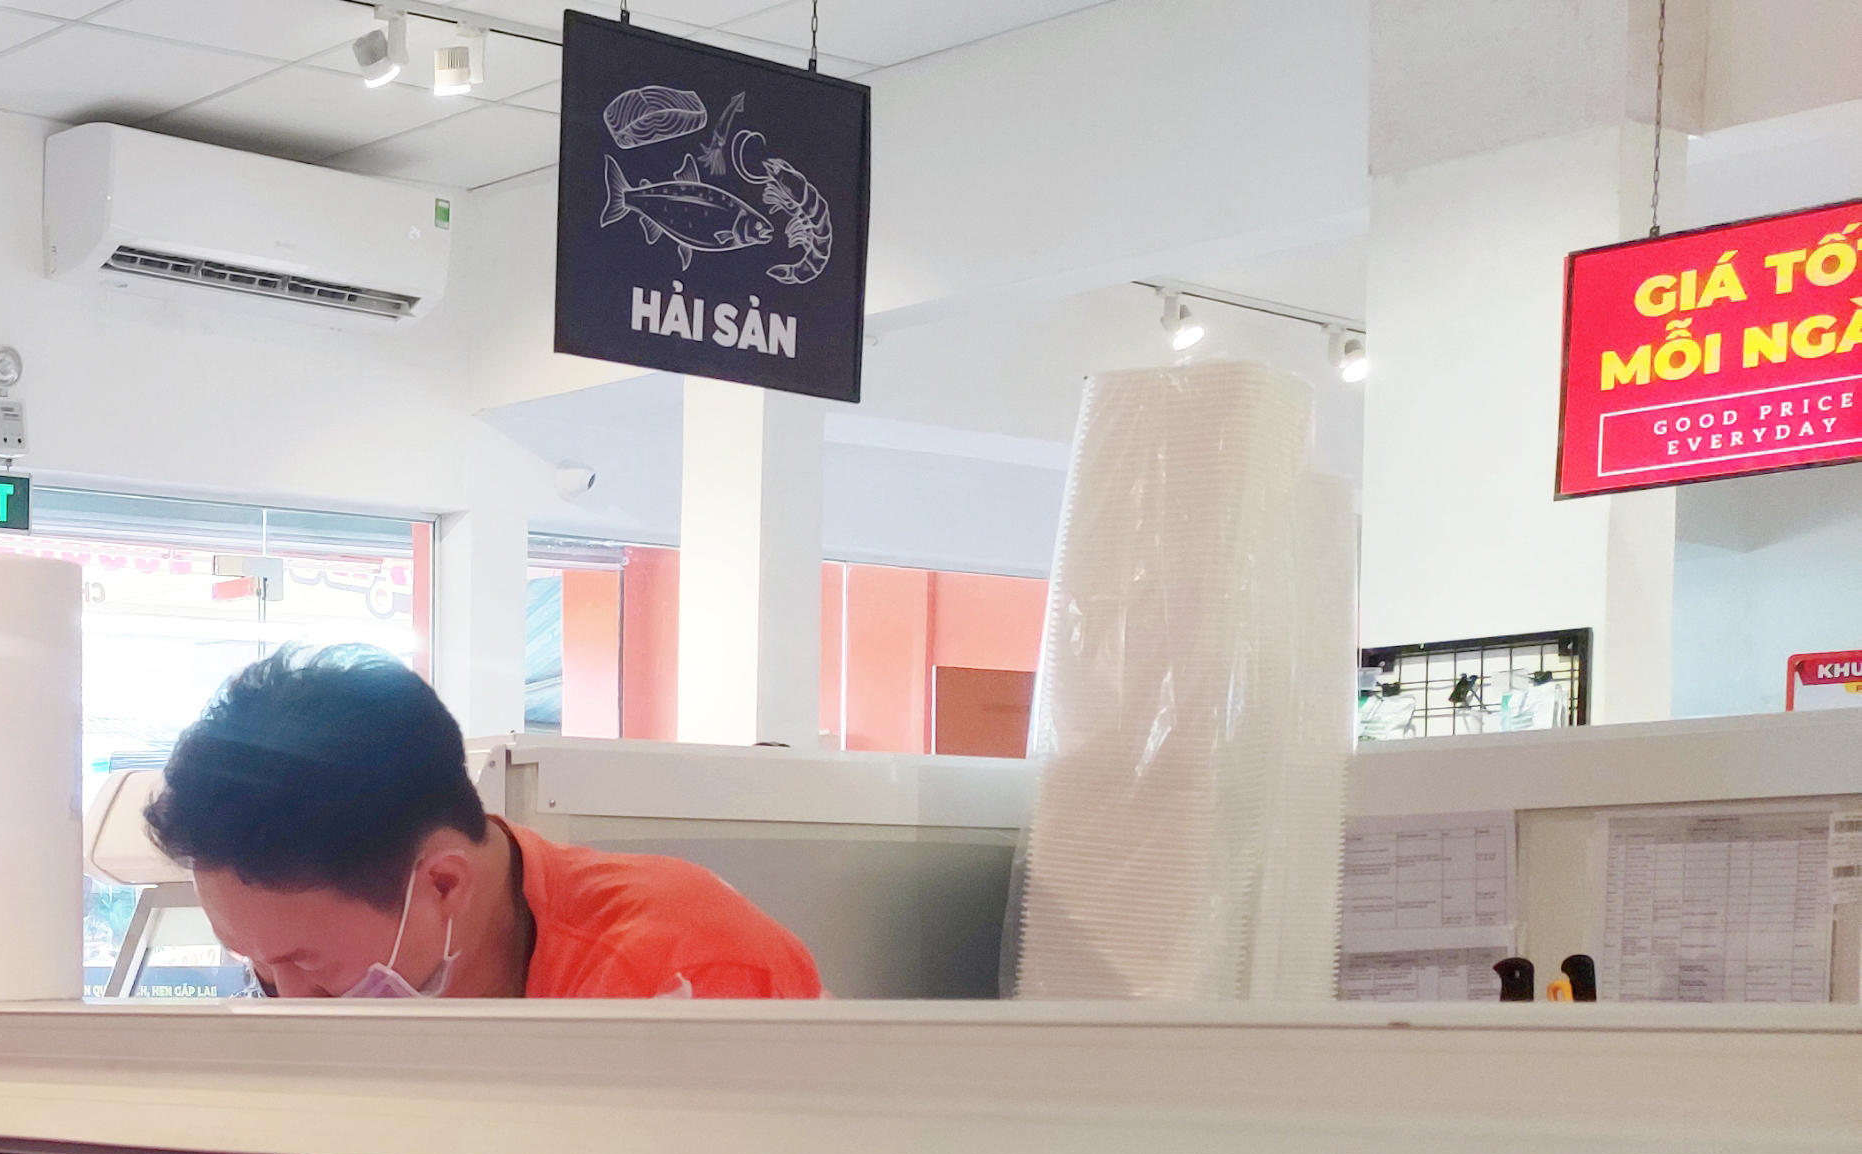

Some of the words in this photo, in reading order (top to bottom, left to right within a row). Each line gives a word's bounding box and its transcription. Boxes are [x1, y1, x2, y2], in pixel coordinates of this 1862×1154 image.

[1634, 249, 1748, 317] GIÁ
[1764, 222, 1862, 295] TỐ
[631, 280, 705, 342] HẢI
[711, 294, 797, 359] SẢN
[1600, 317, 1722, 391] MỖI
[1653, 409, 1738, 435] GOOD
[1758, 392, 1854, 421] PRICE
[1667, 417, 1837, 456] EVERYDAY
